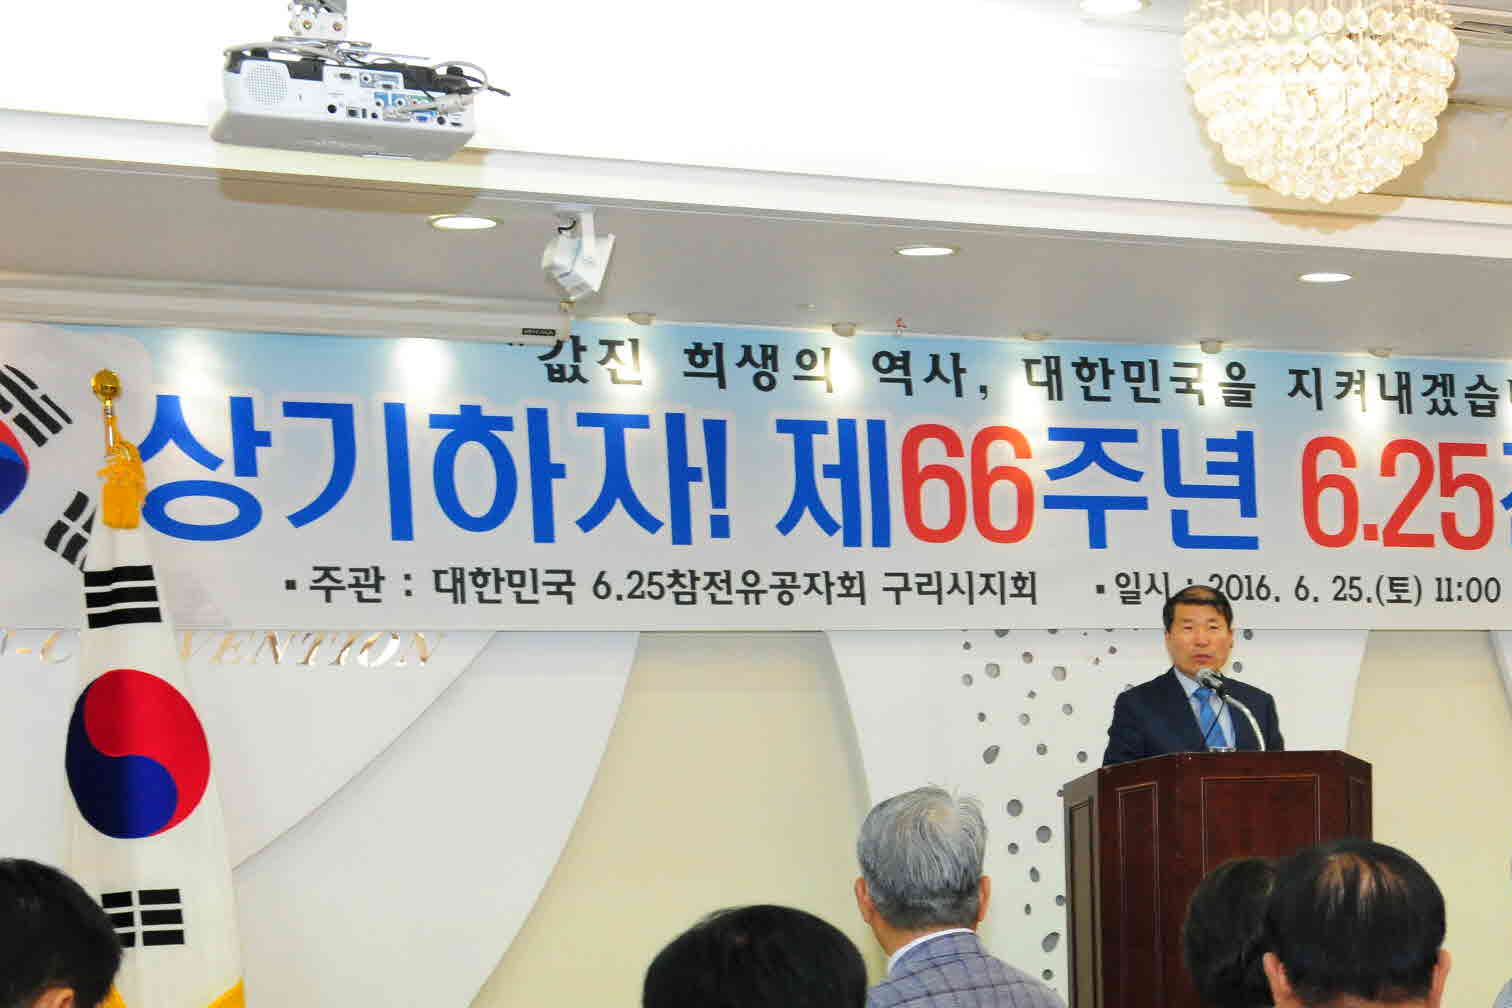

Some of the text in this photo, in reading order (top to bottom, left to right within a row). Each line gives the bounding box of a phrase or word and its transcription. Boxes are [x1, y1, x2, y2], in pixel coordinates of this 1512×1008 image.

[682, 341, 834, 393] 희생의
[871, 349, 989, 400] 역사,
[1021, 354, 1256, 408] 대한민국을
[138, 394, 731, 546] 상기하자!
[775, 418, 1260, 551] 제66주년
[309, 565, 386, 604] 주관
[432, 566, 577, 605] 대한민국
[592, 568, 867, 607] 6.25참전유공자회
[881, 570, 1038, 606] 구리시지회
[1114, 572, 1171, 605] 일시
[1208, 573, 1281, 603] 2016.
[1294, 575, 1320, 603] 6.
[1435, 576, 1502, 604] 11:00
